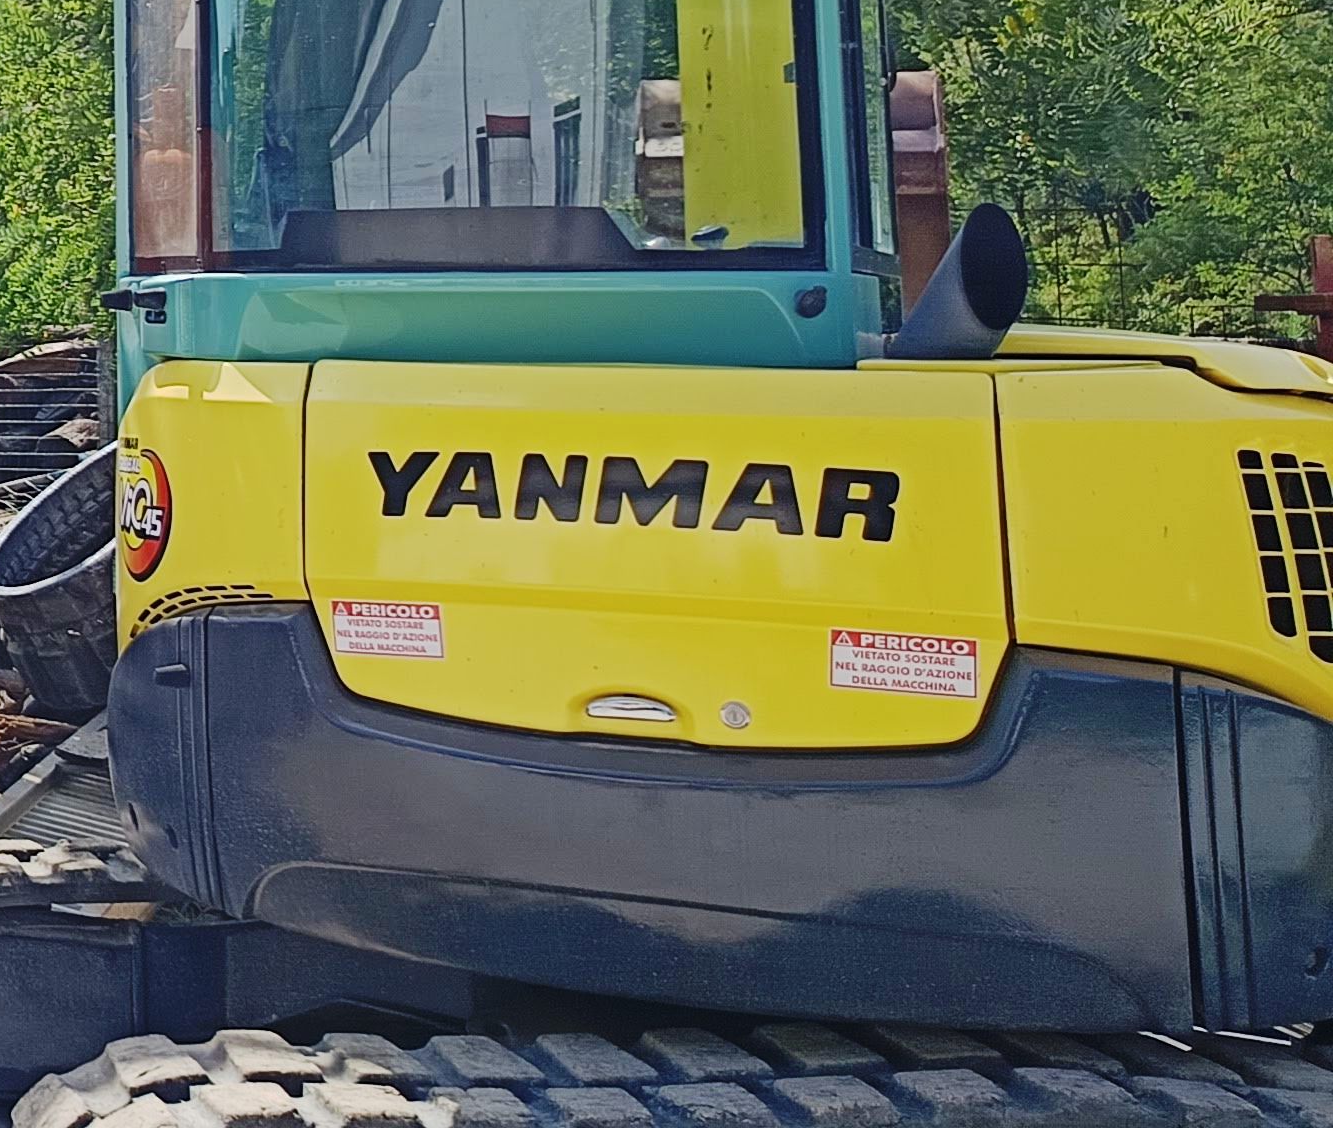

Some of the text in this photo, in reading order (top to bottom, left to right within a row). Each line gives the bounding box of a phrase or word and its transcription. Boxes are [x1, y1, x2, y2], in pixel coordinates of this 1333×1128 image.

[368, 451, 900, 542] YANMAR
[351, 603, 435, 619] PERICOLO
[347, 618, 424, 630] VIETATO SOSTARE
[337, 630, 438, 642] NEL RAGGIO D'AZIONE
[860, 634, 970, 655] PERICOLO
[349, 641, 427, 653] DELLA MACCHINA
[852, 649, 956, 666] VIETATO SOSTARE
[835, 661, 973, 681] NEL RAGGIO D'AZIONE
[852, 675, 957, 692] DELLA MACCHINA
